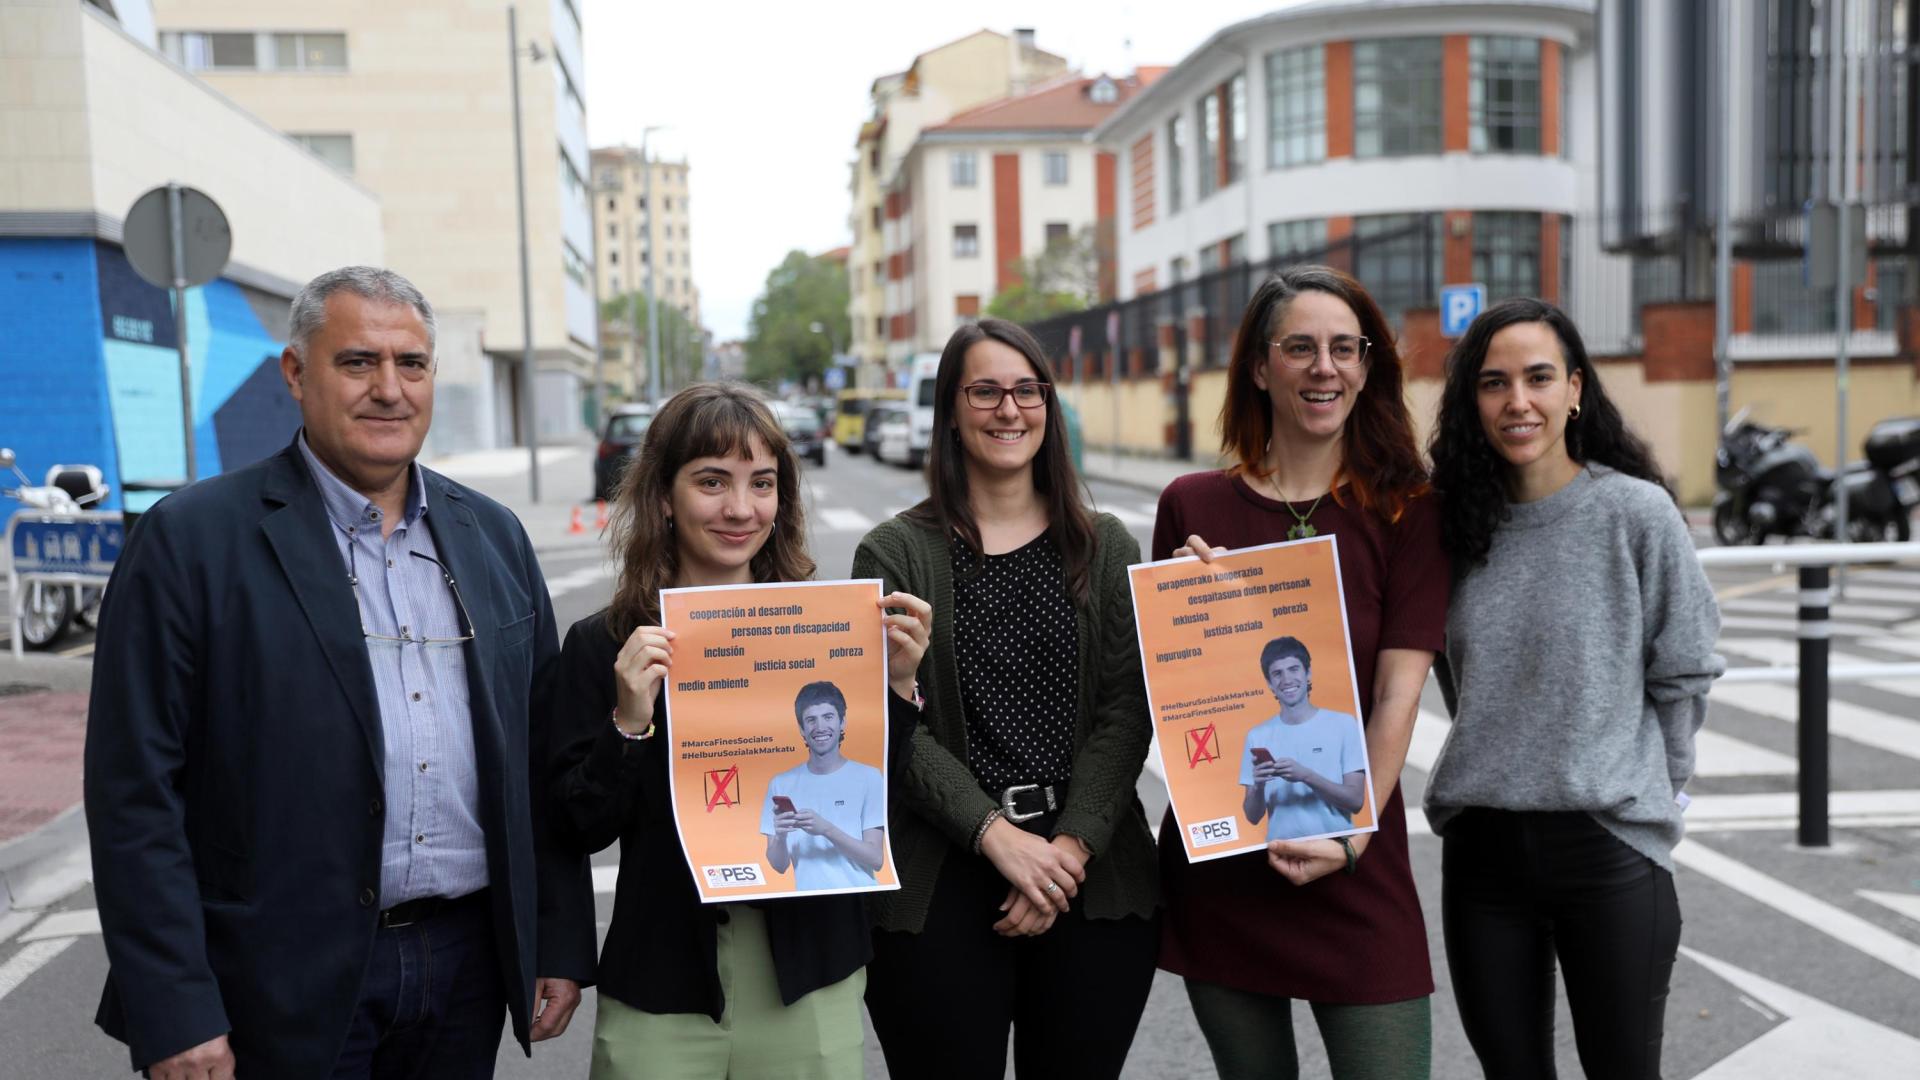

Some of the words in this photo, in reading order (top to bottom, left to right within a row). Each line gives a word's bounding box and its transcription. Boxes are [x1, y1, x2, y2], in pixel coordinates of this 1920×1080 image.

[1448, 294, 1475, 328] P
[1157, 575, 1213, 592] garapenerako
[1214, 566, 1264, 582] kooperazioa
[1188, 587, 1242, 606] desgaitasuna
[1243, 584, 1267, 597] duten
[1269, 577, 1311, 594] pertsonak
[689, 606, 745, 620] cooperación
[747, 605, 756, 617] al
[758, 604, 803, 617] desarrollo
[1272, 602, 1308, 617] pobrezia
[1172, 612, 1209, 626] inklusioa
[731, 626, 772, 638] personas
[775, 626, 791, 636] con
[793, 621, 850, 636] discapacidad
[1204, 626, 1233, 639] justizia
[1234, 620, 1264, 633] soziala
[704, 646, 745, 658] inclusión
[829, 646, 863, 659] pobreza
[1156, 647, 1202, 663] ingurugiroa
[754, 659, 786, 672] justicia
[788, 658, 815, 670] social
[678, 679, 705, 692] medio
[708, 678, 749, 690] ambiente
[1162, 703, 1245, 722] #MarcaFinesSociales
[681, 736, 774, 748] #MarcaFinesSociales
[681, 745, 796, 760] #HelburuSozialakMarkatu
